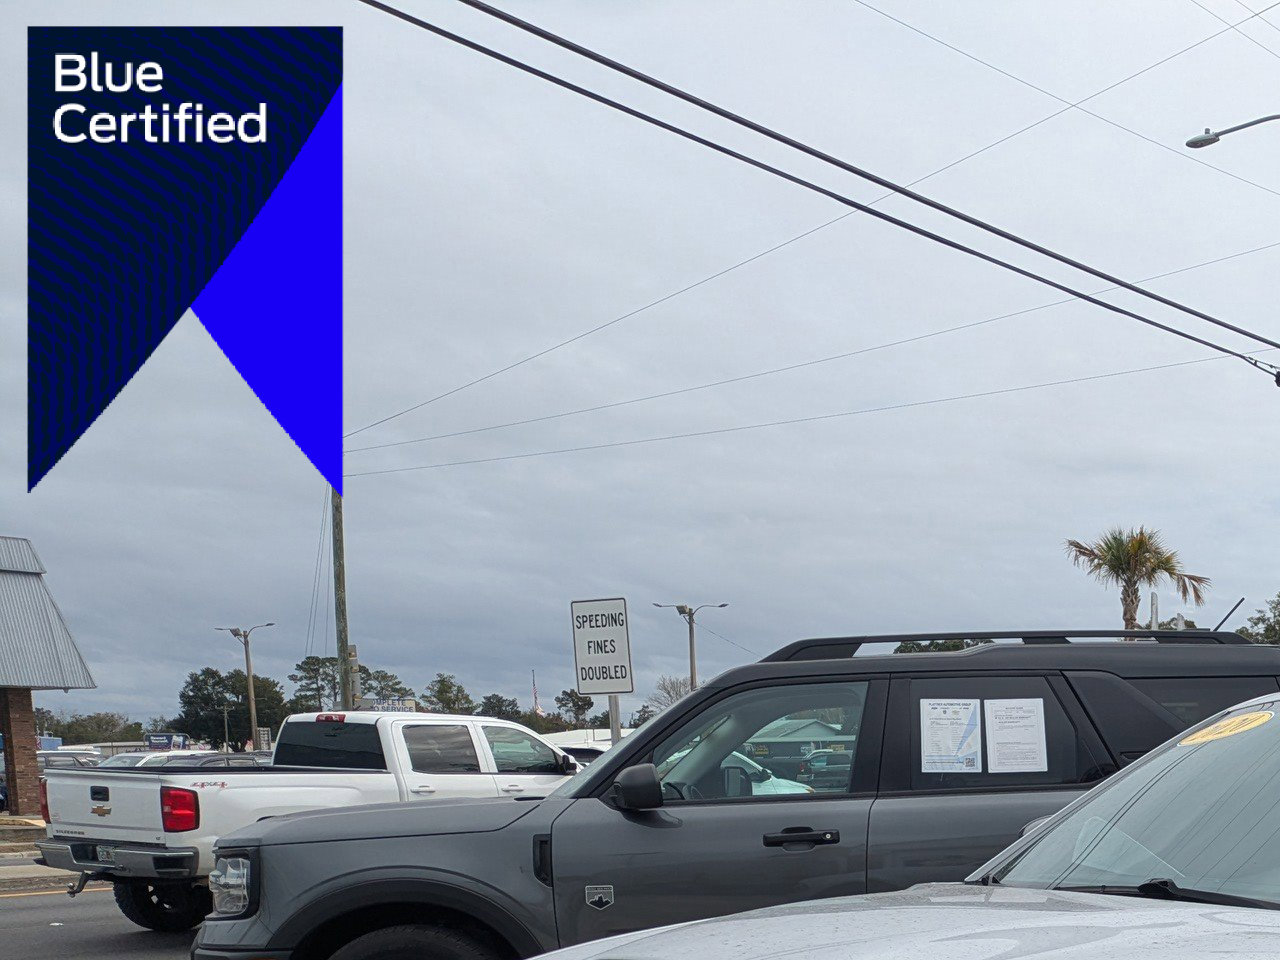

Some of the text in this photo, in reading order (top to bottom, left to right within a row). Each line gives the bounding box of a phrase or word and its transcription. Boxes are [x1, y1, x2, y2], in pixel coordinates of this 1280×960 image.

[575, 612, 624, 629] SPEEDING
[587, 639, 616, 654] FINES
[580, 665, 627, 681] DOUBLED
